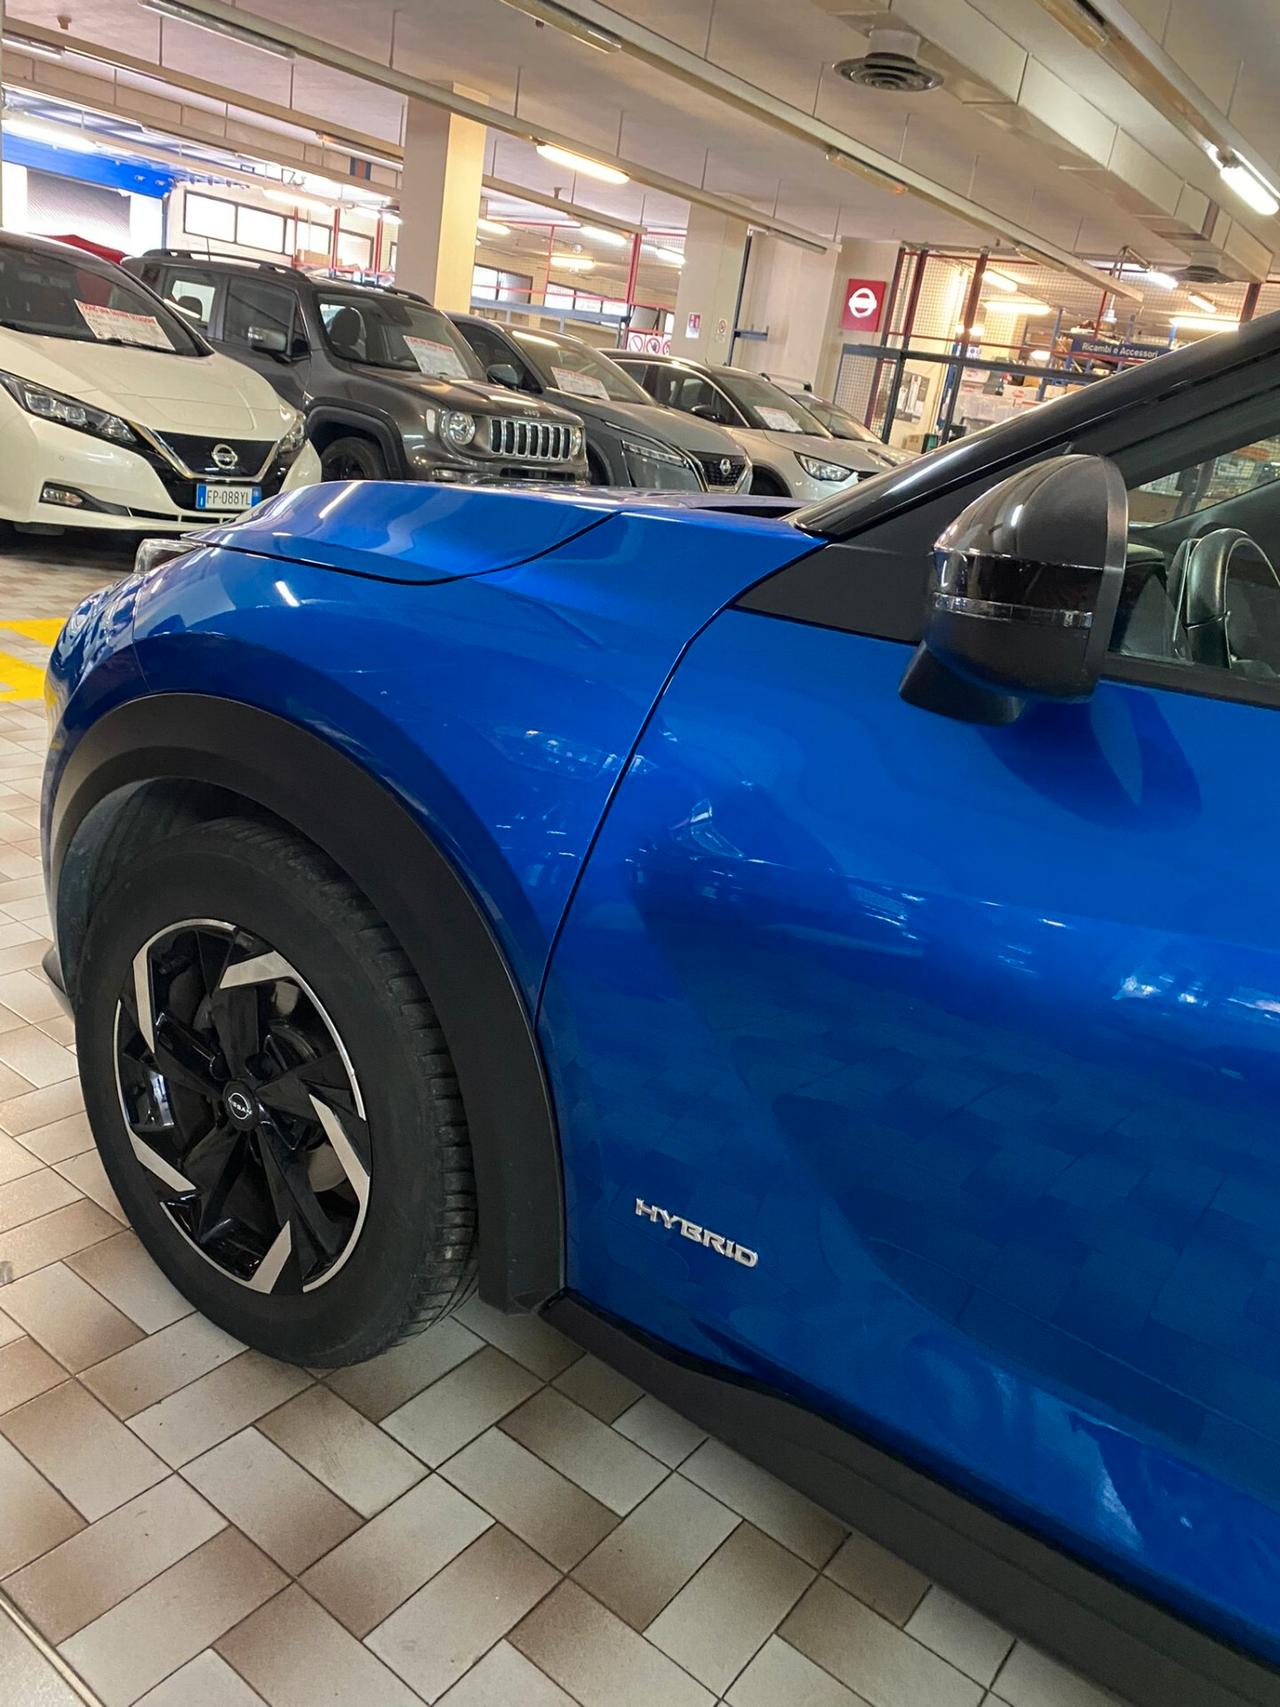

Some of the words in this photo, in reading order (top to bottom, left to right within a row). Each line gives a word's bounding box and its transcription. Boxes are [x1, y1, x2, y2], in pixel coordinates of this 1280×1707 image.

[1082, 342, 1112, 354] Ricambi
[1120, 347, 1158, 358] Accessori
[635, 1198, 759, 1268] HYBRID
